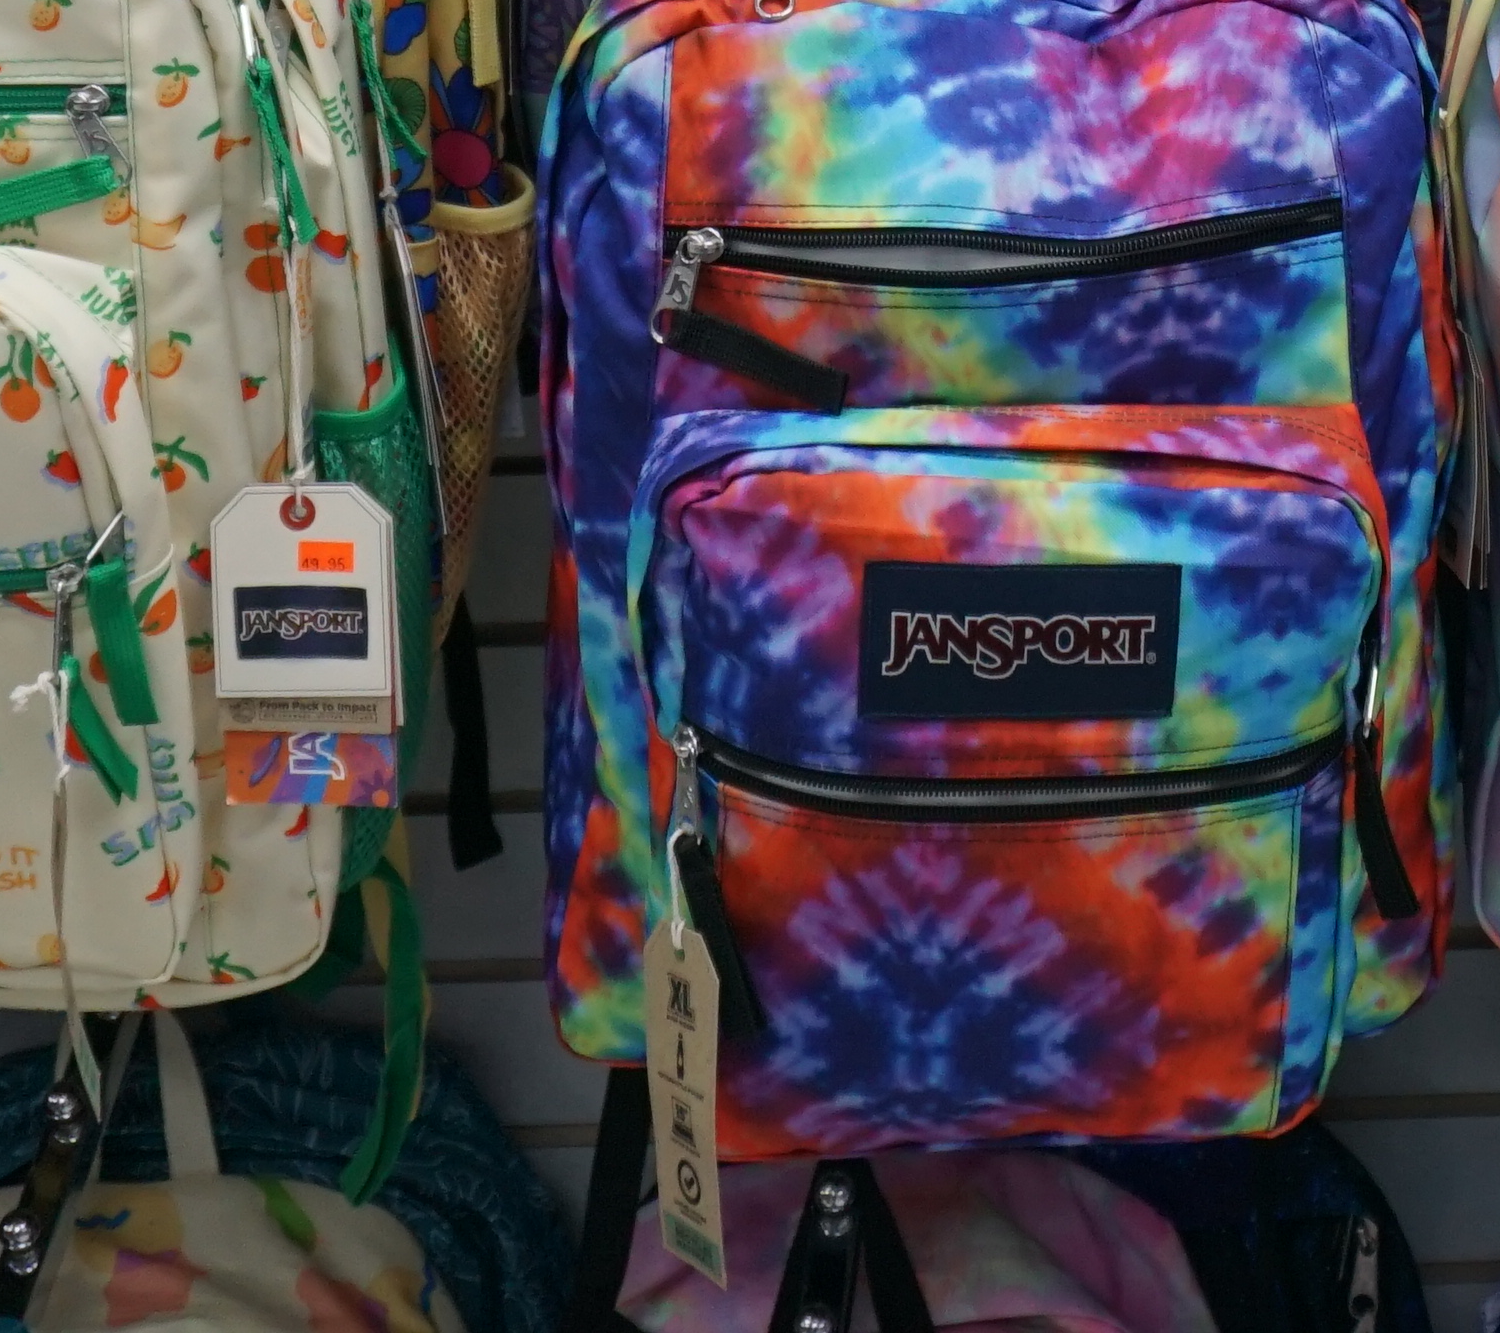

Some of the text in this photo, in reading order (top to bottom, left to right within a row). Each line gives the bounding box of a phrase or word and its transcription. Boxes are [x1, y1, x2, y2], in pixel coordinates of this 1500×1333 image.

[241, 609, 363, 641] JANSPORT
[882, 612, 1156, 679] JANSPORT
[258, 700, 377, 715] From Pack to Impact
[9, 846, 39, 867] IT
[669, 974, 695, 1020] XL
